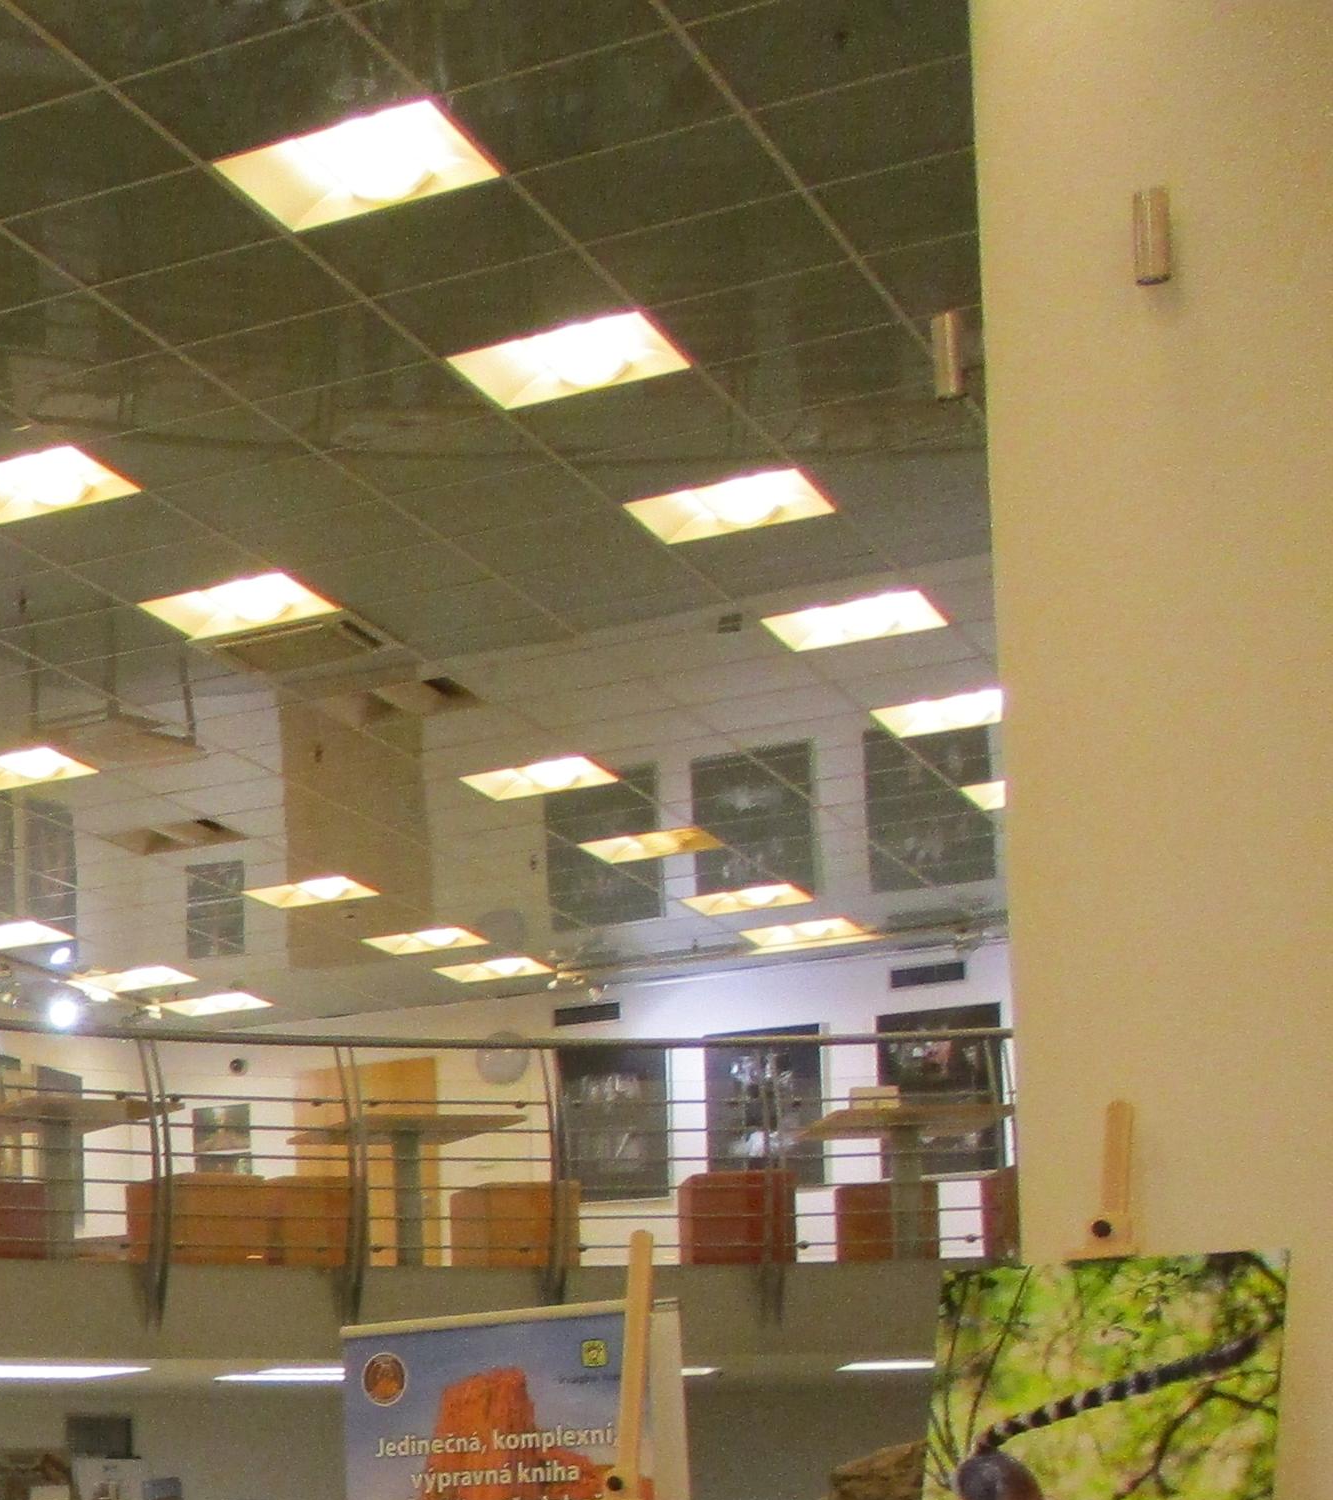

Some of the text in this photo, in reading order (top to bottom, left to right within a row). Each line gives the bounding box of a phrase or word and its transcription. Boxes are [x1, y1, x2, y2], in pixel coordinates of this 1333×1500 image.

[374, 1432, 487, 1459] Jedinečná,
[410, 1460, 580, 1494] výpravná kniha
